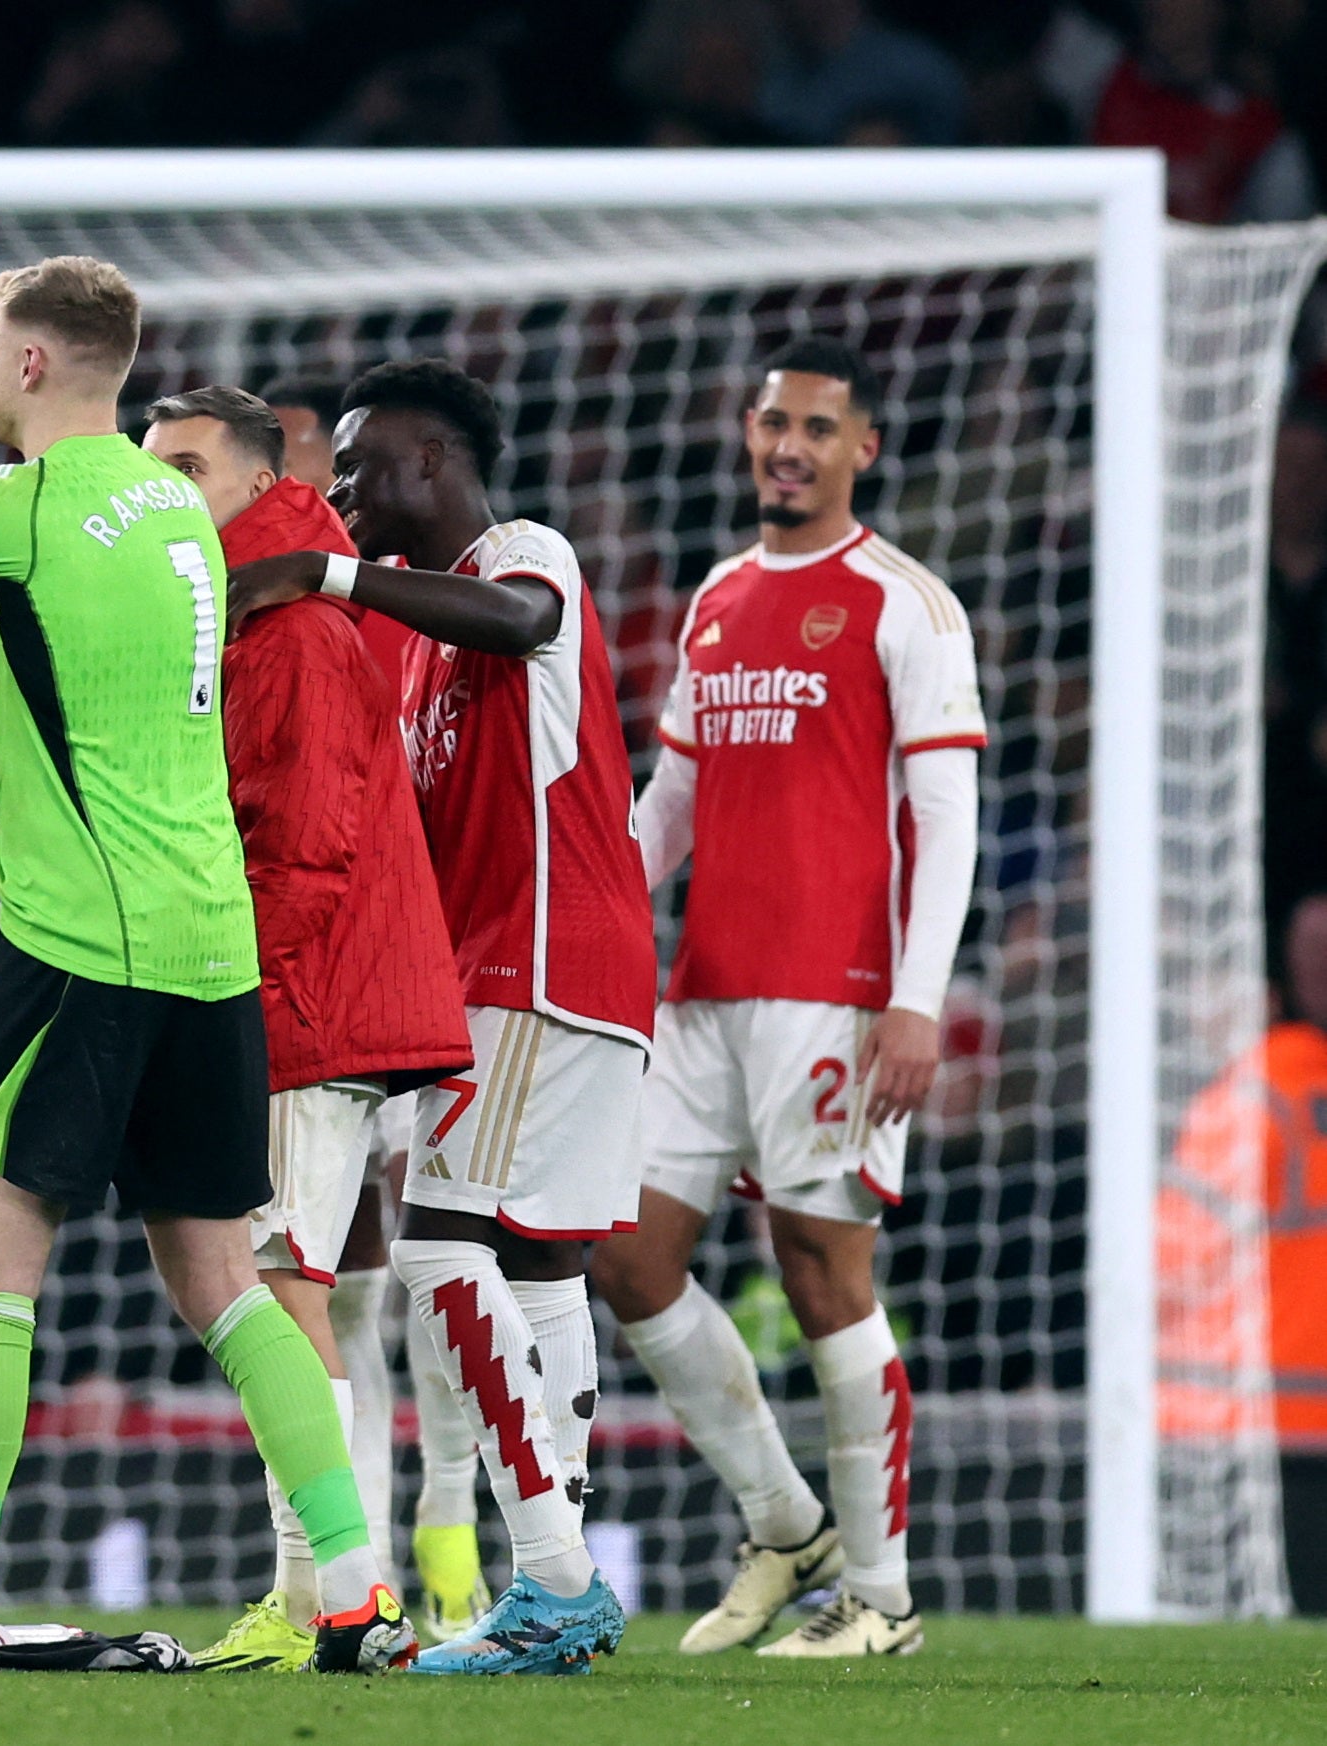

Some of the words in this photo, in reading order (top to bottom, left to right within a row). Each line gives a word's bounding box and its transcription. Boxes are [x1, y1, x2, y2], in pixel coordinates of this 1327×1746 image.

[165, 540, 217, 714] 1
[690, 660, 829, 713] Emirates
[729, 708, 798, 745] BETTER
[425, 1075, 479, 1149] 7
[809, 1056, 847, 1124] 2
